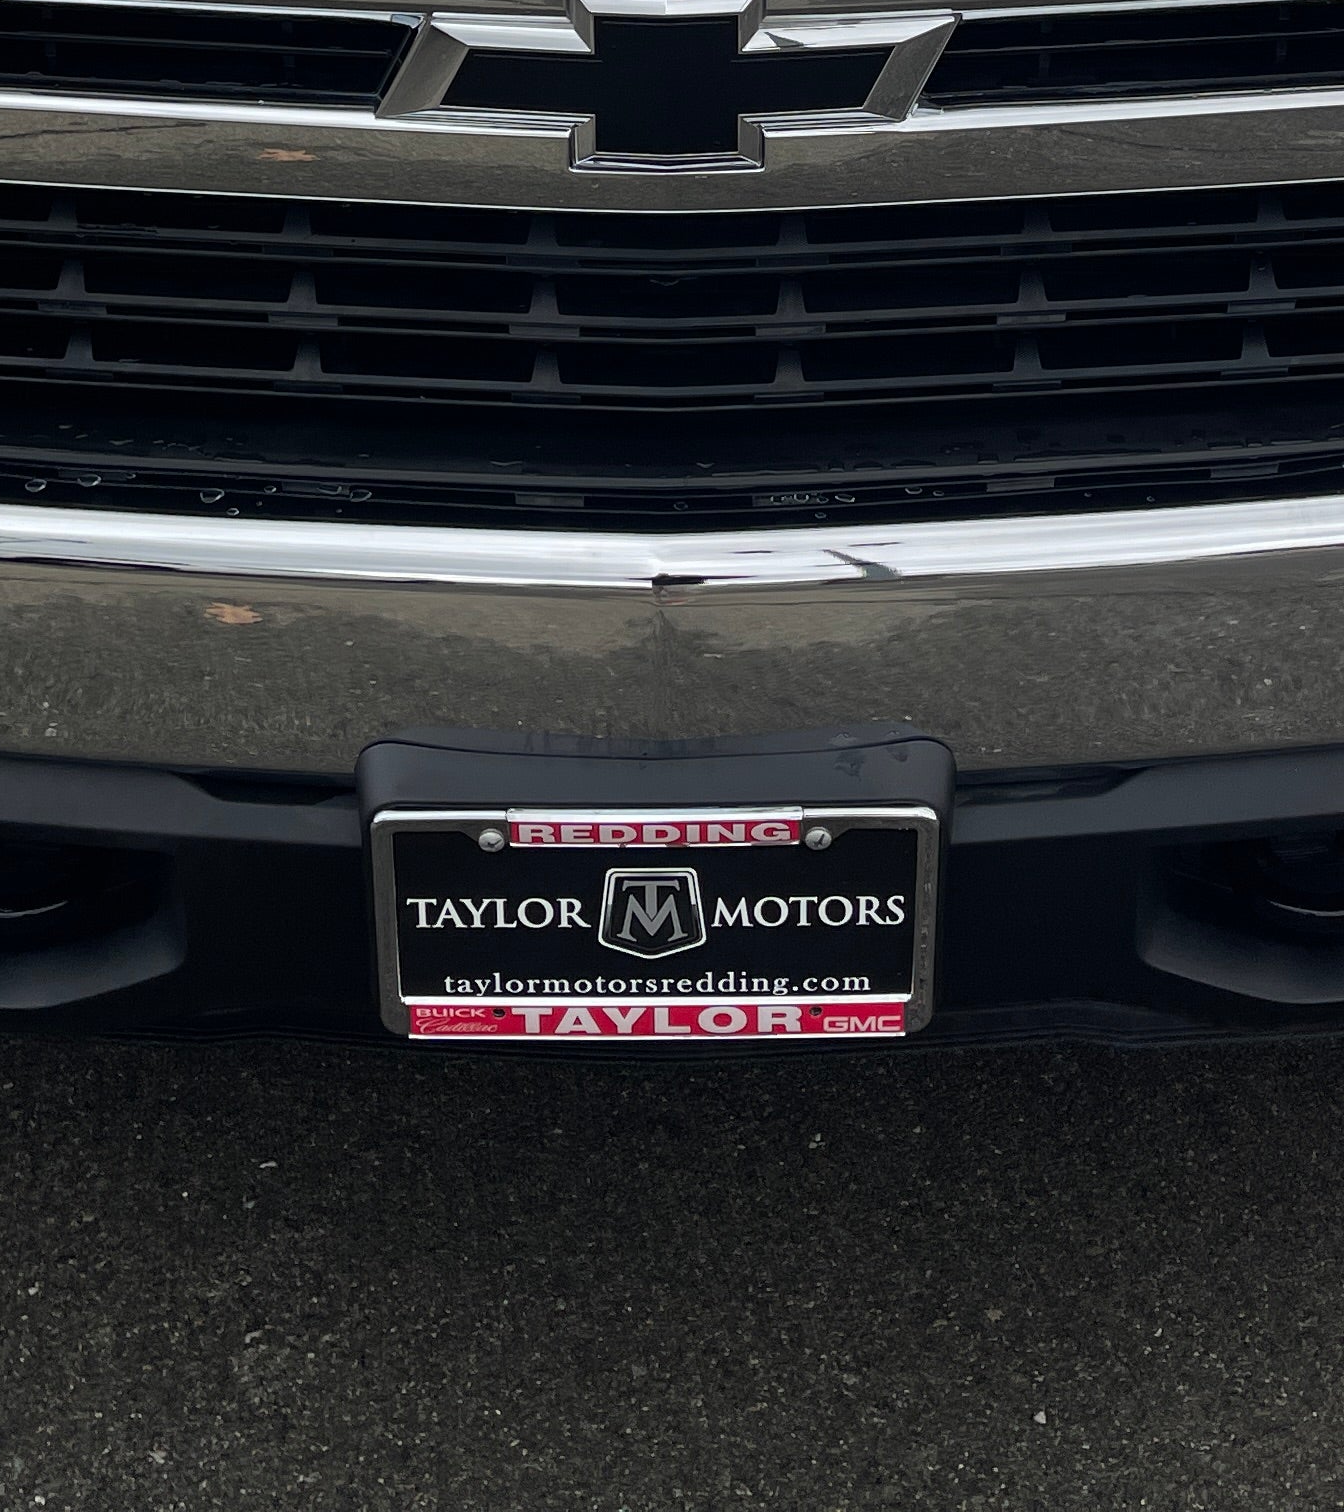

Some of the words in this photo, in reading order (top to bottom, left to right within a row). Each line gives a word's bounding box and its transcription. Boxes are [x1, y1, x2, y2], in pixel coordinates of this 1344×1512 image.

[519, 822, 791, 843] REDDING
[407, 898, 591, 928] TAYLOR
[711, 895, 906, 928] MOTORS
[444, 972, 871, 996] taylormotorsredding.com
[416, 1008, 486, 1018] BUICK
[511, 1006, 803, 1034] TAYLOR
[822, 1015, 901, 1033] GMC
